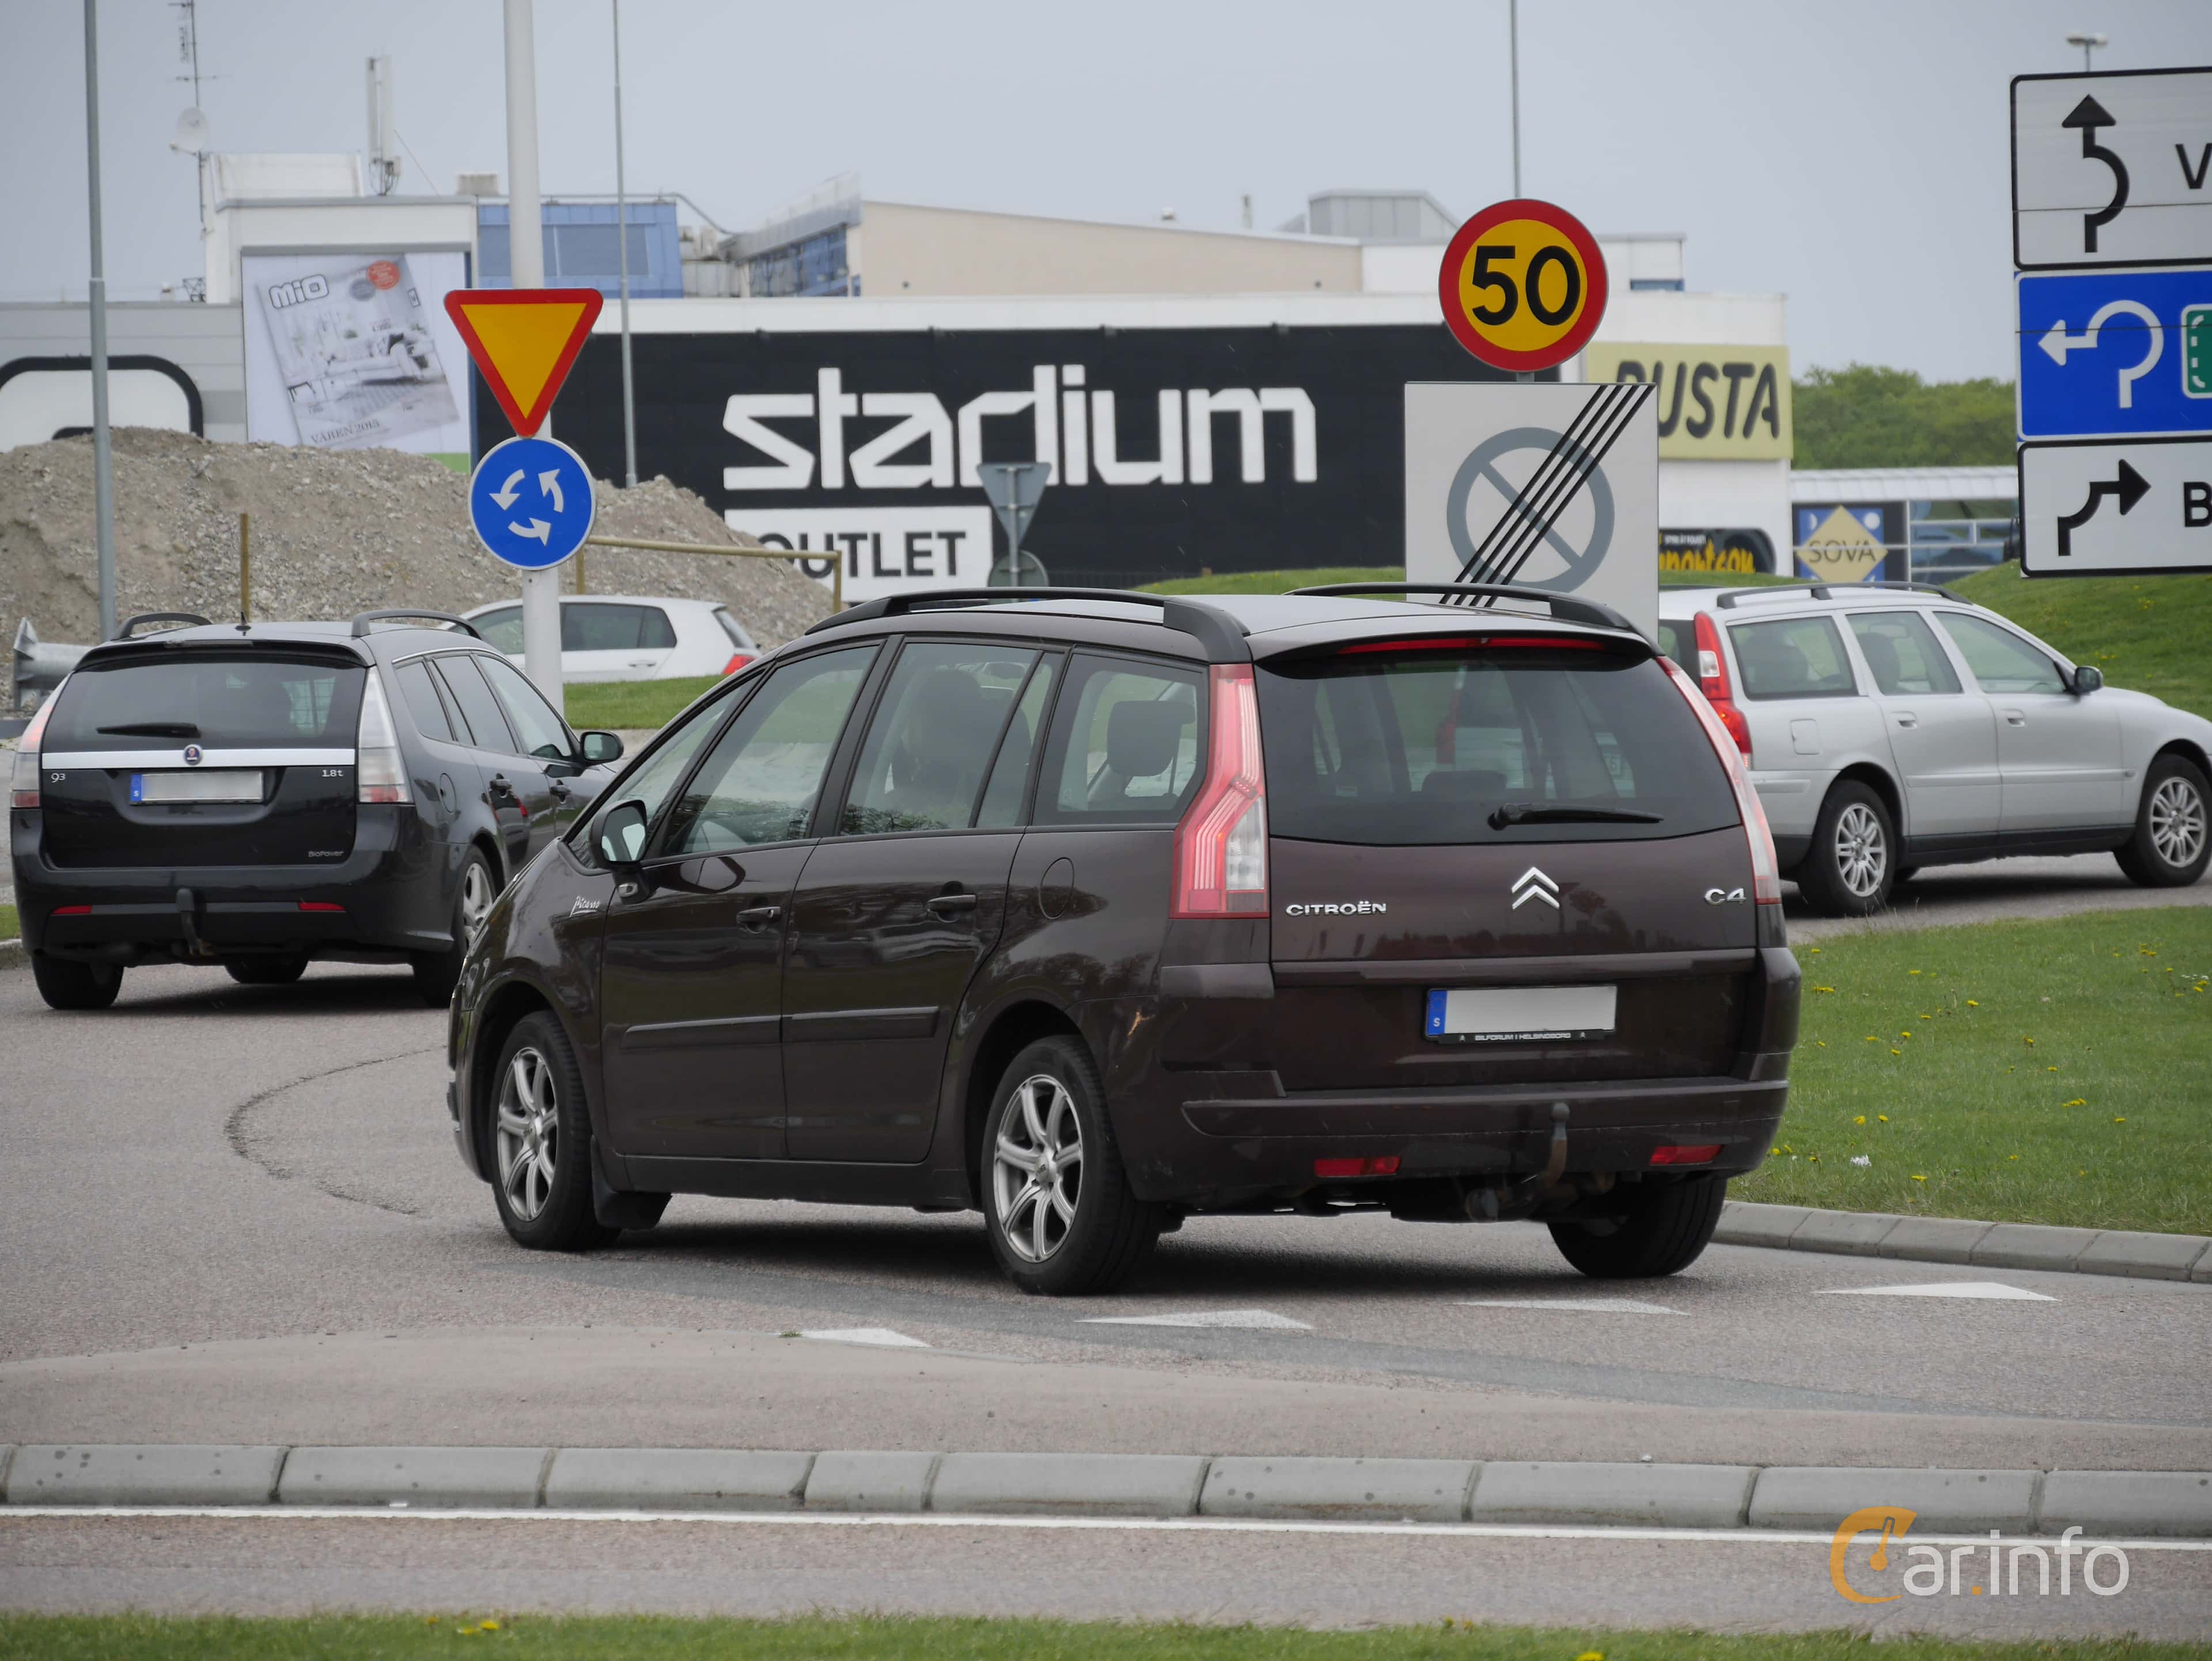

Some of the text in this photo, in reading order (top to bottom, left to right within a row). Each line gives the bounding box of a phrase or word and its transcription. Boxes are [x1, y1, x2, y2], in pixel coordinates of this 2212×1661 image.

[1471, 245, 1581, 327] 50
[1616, 360, 1781, 440] USTA
[723, 364, 1317, 490] stadium
[1809, 540, 1876, 563] SOVA
[1705, 888, 1747, 905] C4
[1286, 901, 1387, 916] CITROËN
[1433, 1017, 1440, 1027] S
